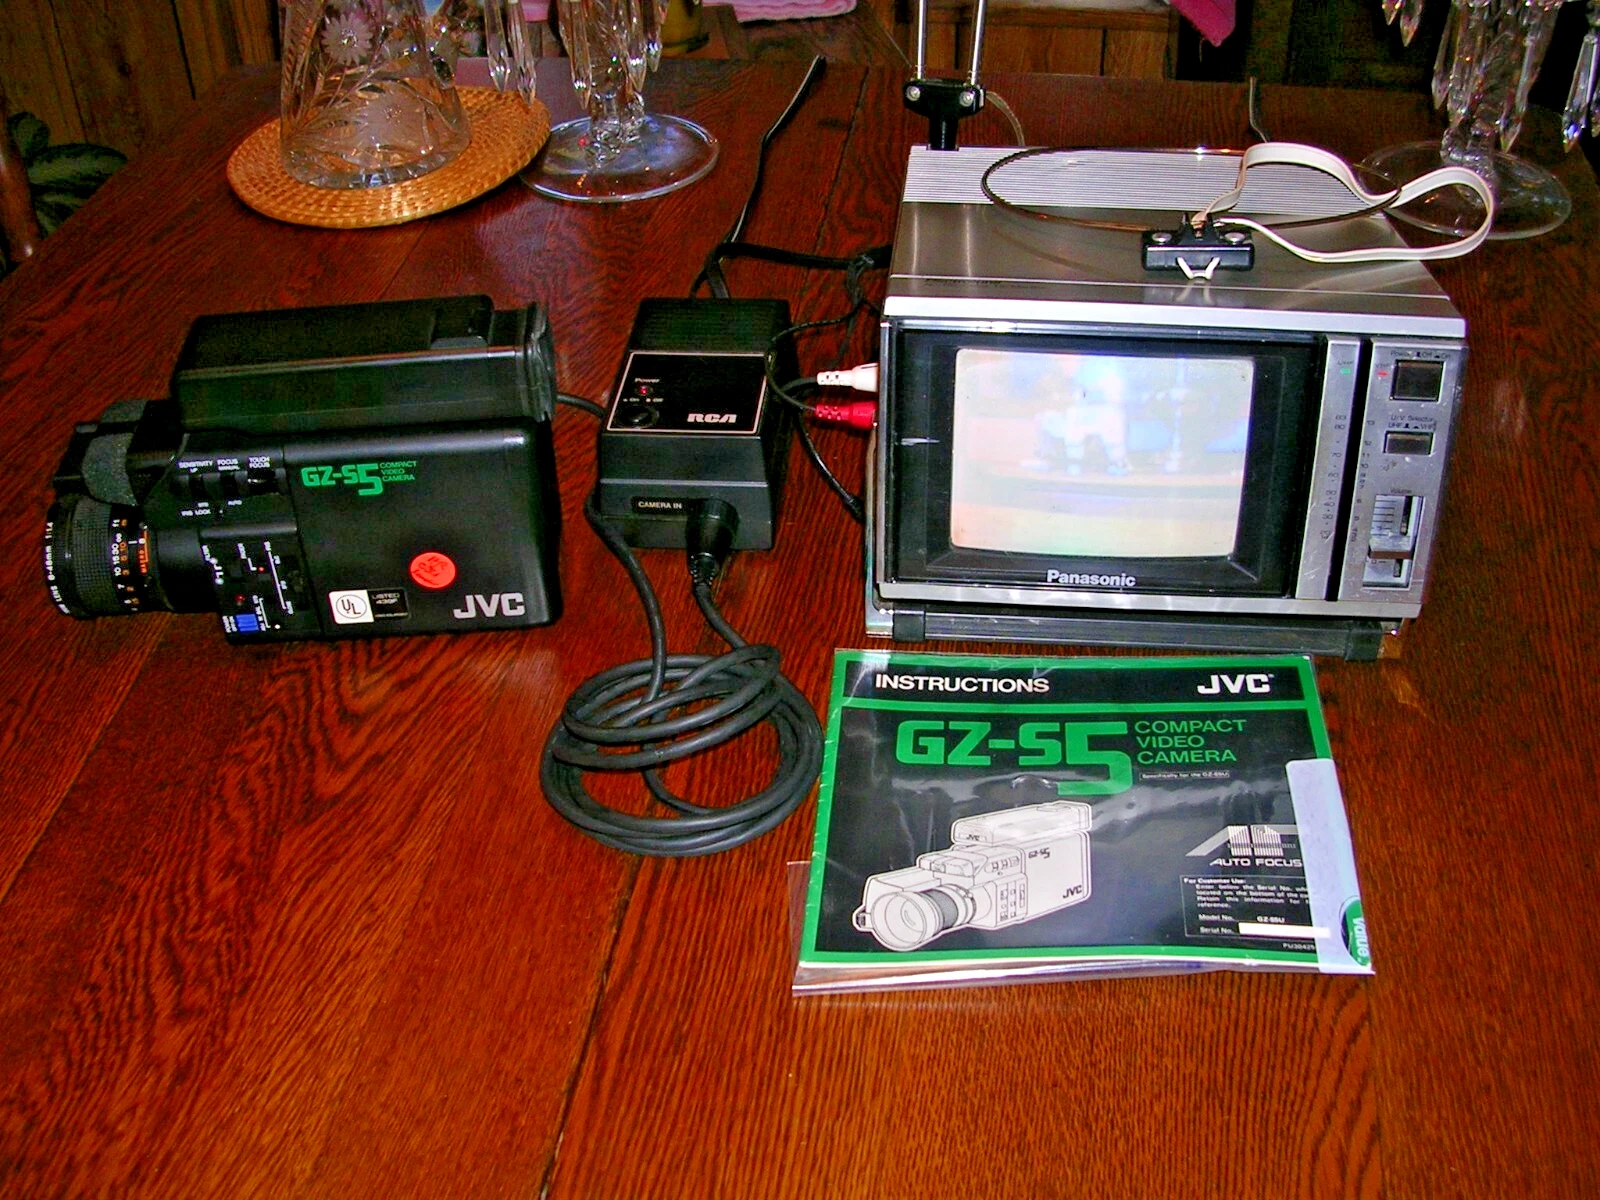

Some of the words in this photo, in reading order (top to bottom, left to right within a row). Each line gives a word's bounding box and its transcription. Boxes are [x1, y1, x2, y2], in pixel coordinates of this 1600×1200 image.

[686, 413, 738, 424] RCA
[178, 460, 213, 469] SENSITIVITY
[380, 460, 417, 469] COMPACT
[301, 462, 384, 496] GZ-S5
[382, 474, 415, 482] CAMERA
[638, 501, 672, 509] CAMERA
[673, 502, 682, 510] IN
[1046, 569, 1136, 587] Panasonic
[453, 592, 525, 619] JVC
[875, 673, 1050, 694] INSTRUCTIONS
[1197, 674, 1271, 695] JVC
[1134, 719, 1248, 734] COMPACT
[1136, 735, 1205, 749] VIDEO
[895, 719, 1133, 796] GZ-S5
[1137, 750, 1237, 765] CAMERA
[1210, 858, 1251, 867] AUTO
[1256, 858, 1303, 868] FOCUS
[1062, 884, 1083, 899] JVC
